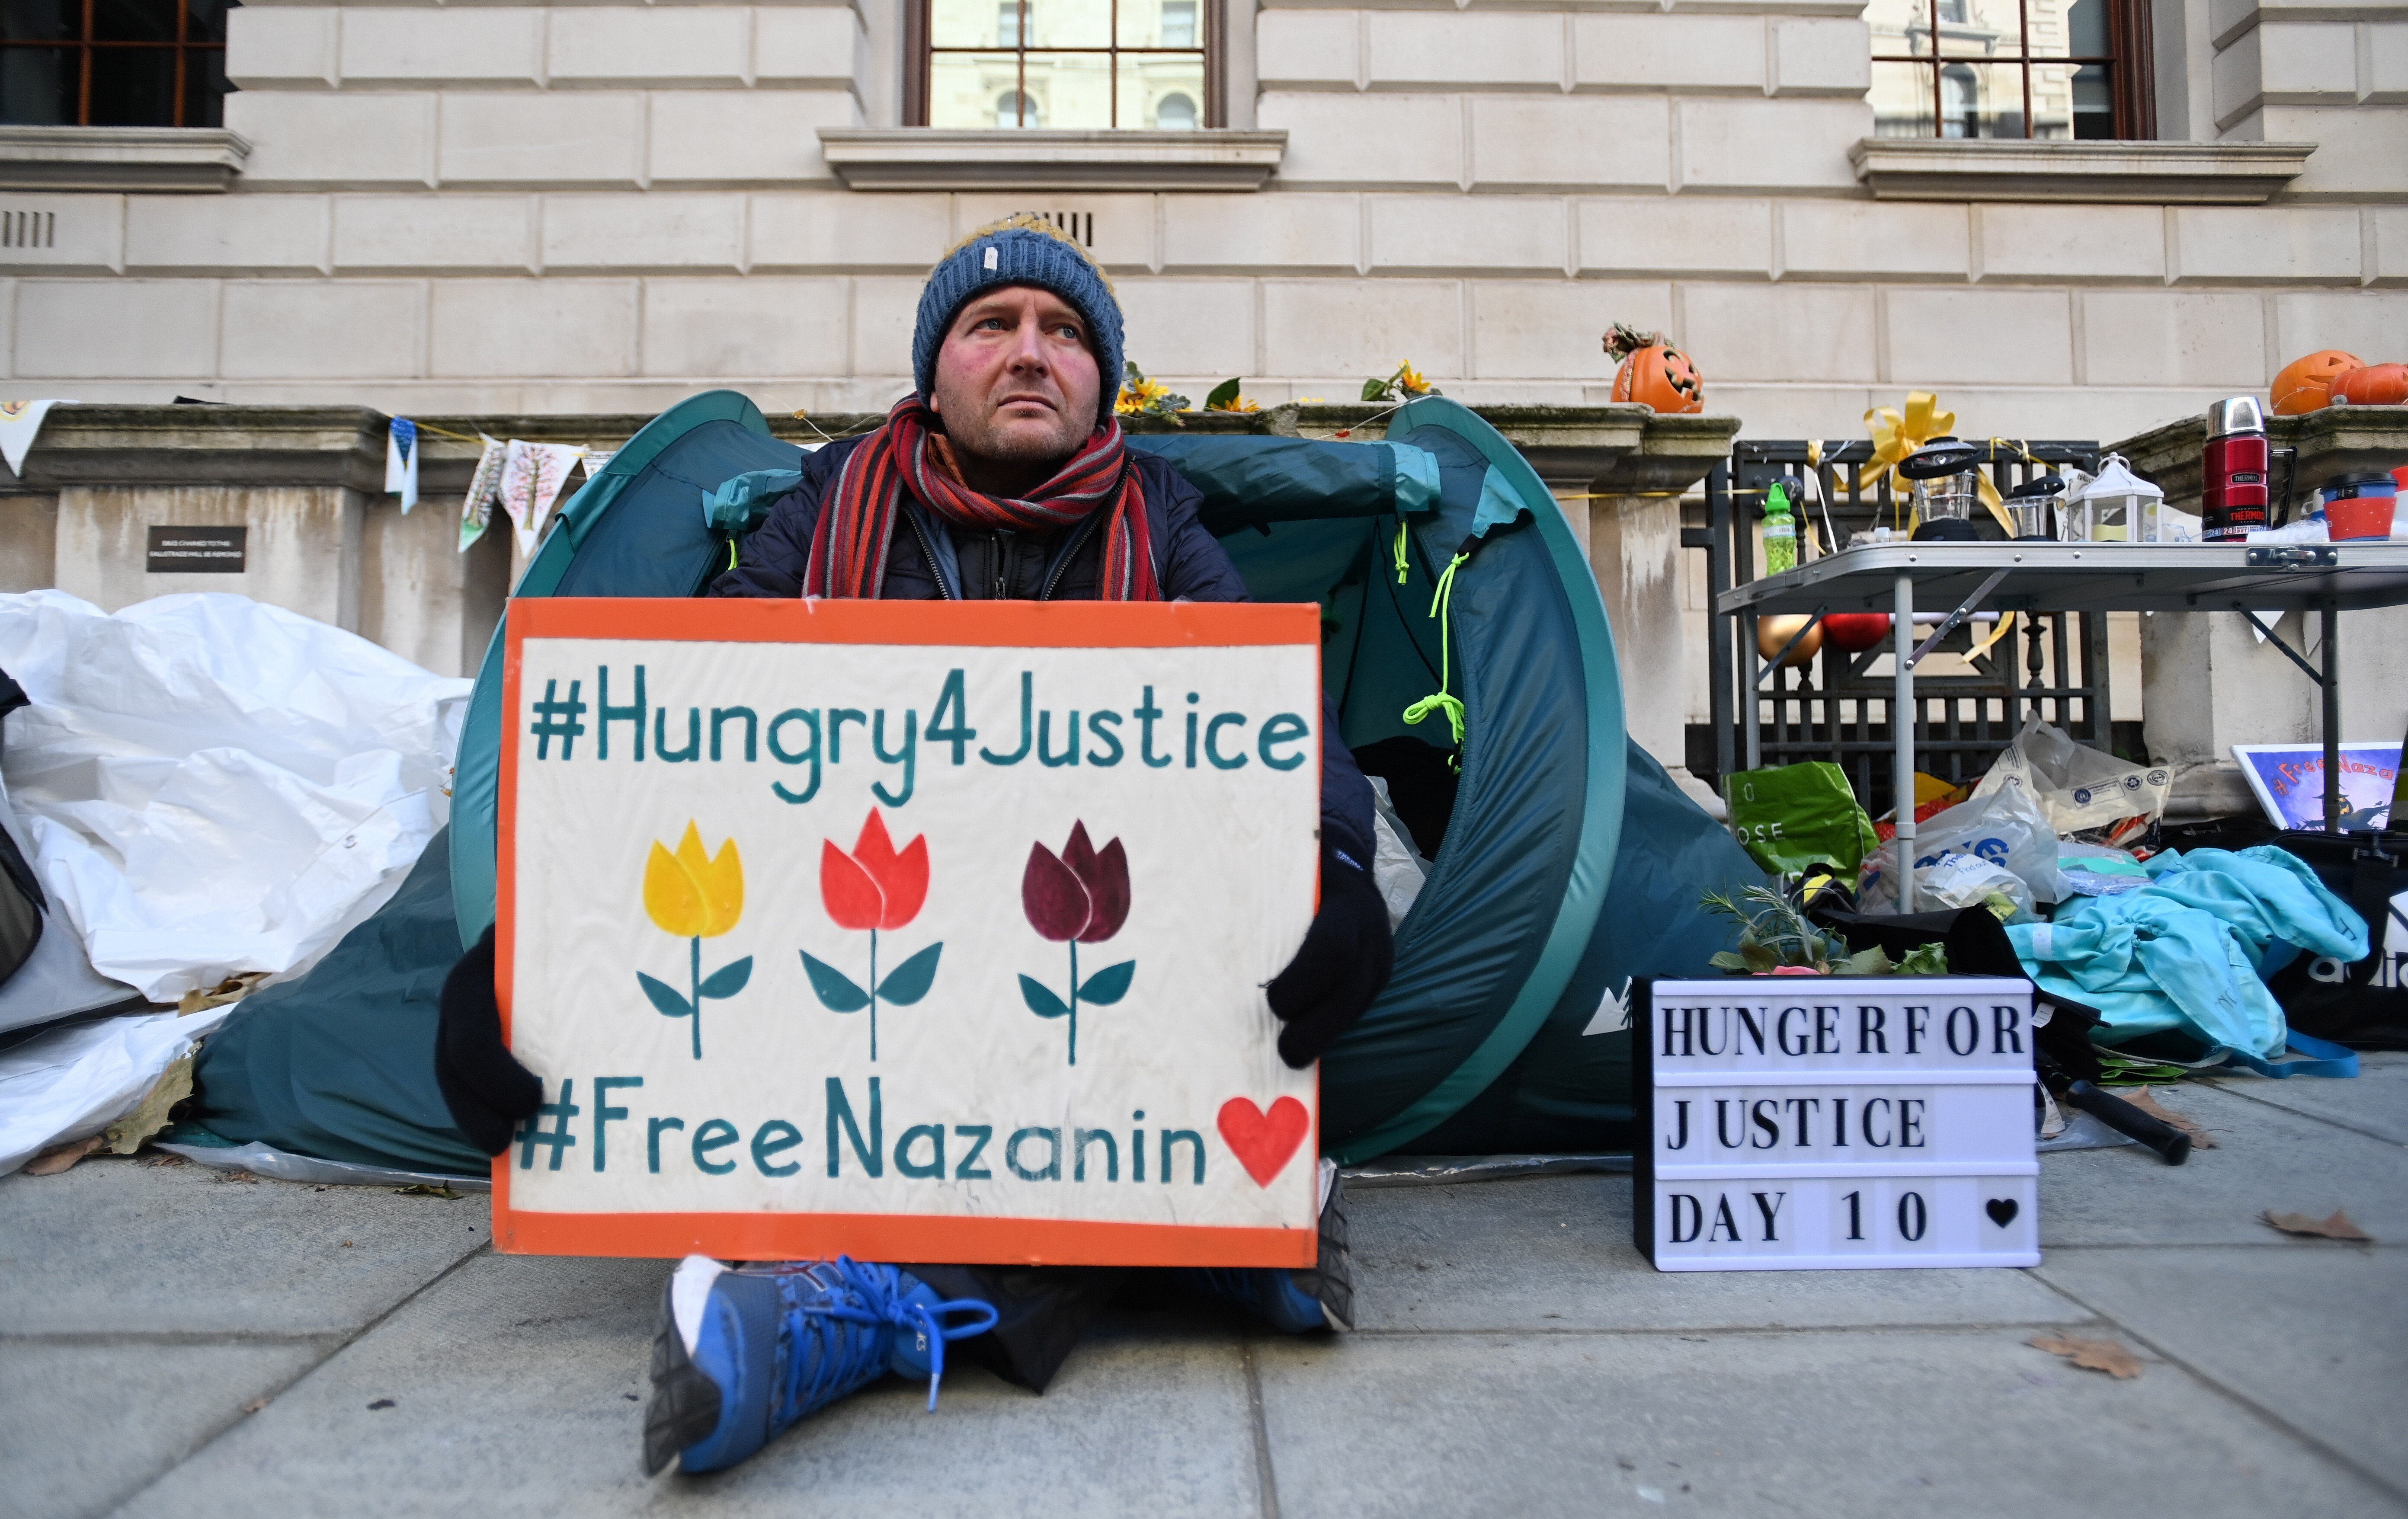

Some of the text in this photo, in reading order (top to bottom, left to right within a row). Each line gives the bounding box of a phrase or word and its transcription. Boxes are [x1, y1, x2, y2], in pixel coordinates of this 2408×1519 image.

[2230, 510, 2265, 521] THERMOS
[531, 664, 1310, 808] #Hungry4Justice
[513, 1076, 1207, 1185] #FreeNazanin
[1667, 1098, 1926, 1150] JUSTICE
[1669, 1191, 1927, 1244] DAY 10
